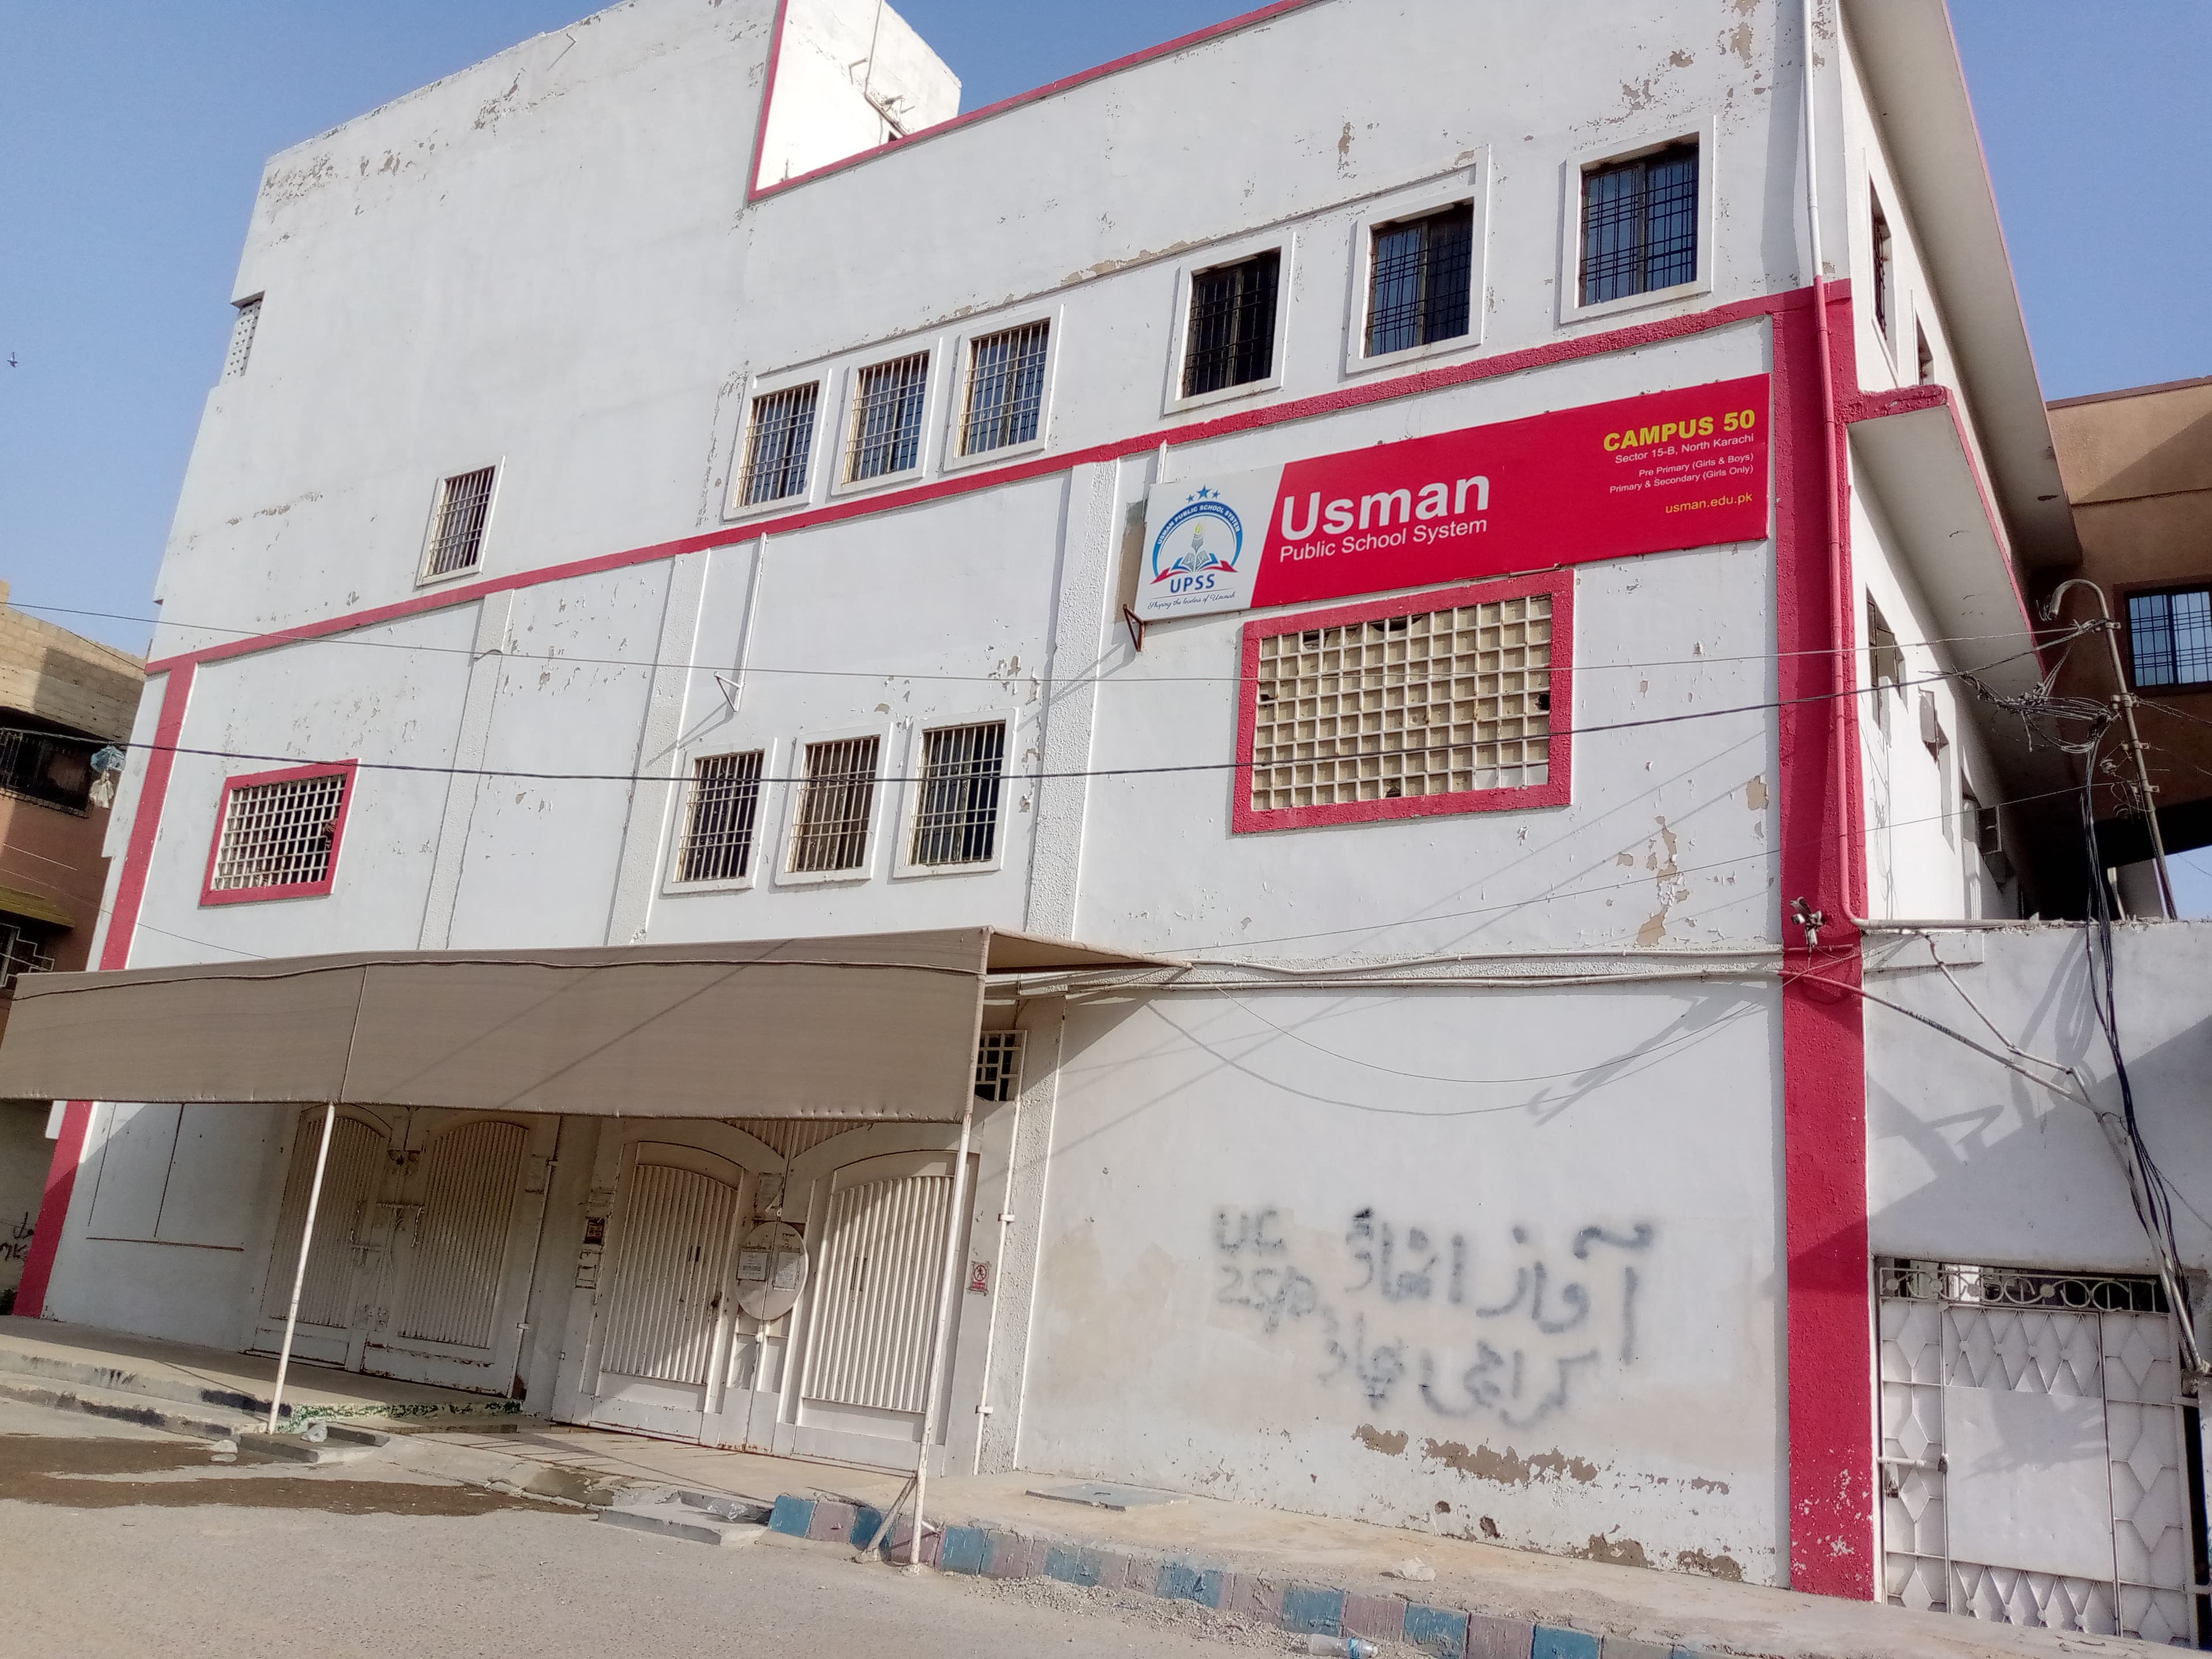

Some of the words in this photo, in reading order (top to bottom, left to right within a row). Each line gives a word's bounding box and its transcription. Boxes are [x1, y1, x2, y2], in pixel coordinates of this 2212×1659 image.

[1604, 416, 1714, 452] CAMPUS
[1723, 409, 1755, 431] 50
[1615, 452, 1648, 464] Sector
[1652, 446, 1678, 458] 15-B,
[1681, 441, 1710, 453] North
[1713, 433, 1754, 448] Karachi
[1609, 482, 1642, 494] Primary
[1644, 479, 1652, 488] &
[1653, 474, 1700, 487] Secondary
[1703, 468, 1726, 480] (Girls
[1729, 464, 1754, 475] Only)
[1639, 469, 1654, 478] Pre
[1656, 463, 1690, 476] Primary
[1692, 459, 1715, 471] (Girls
[1718, 456, 1725, 465] &
[1728, 452, 1754, 465] Boys)
[1281, 475, 1490, 541] Usman
[1665, 491, 1753, 514] usman.edu.pk
[1157, 521, 1175, 545] USMAN
[1175, 506, 1198, 523] PUBLIC
[1199, 504, 1225, 514] SCHOOL
[1279, 540, 1336, 563] Public
[1341, 528, 1407, 554] School
[1412, 519, 1487, 545] System
[1170, 574, 1215, 593] UPSS
[1173, 597, 1181, 607] the
[1202, 595, 1210, 605] of
